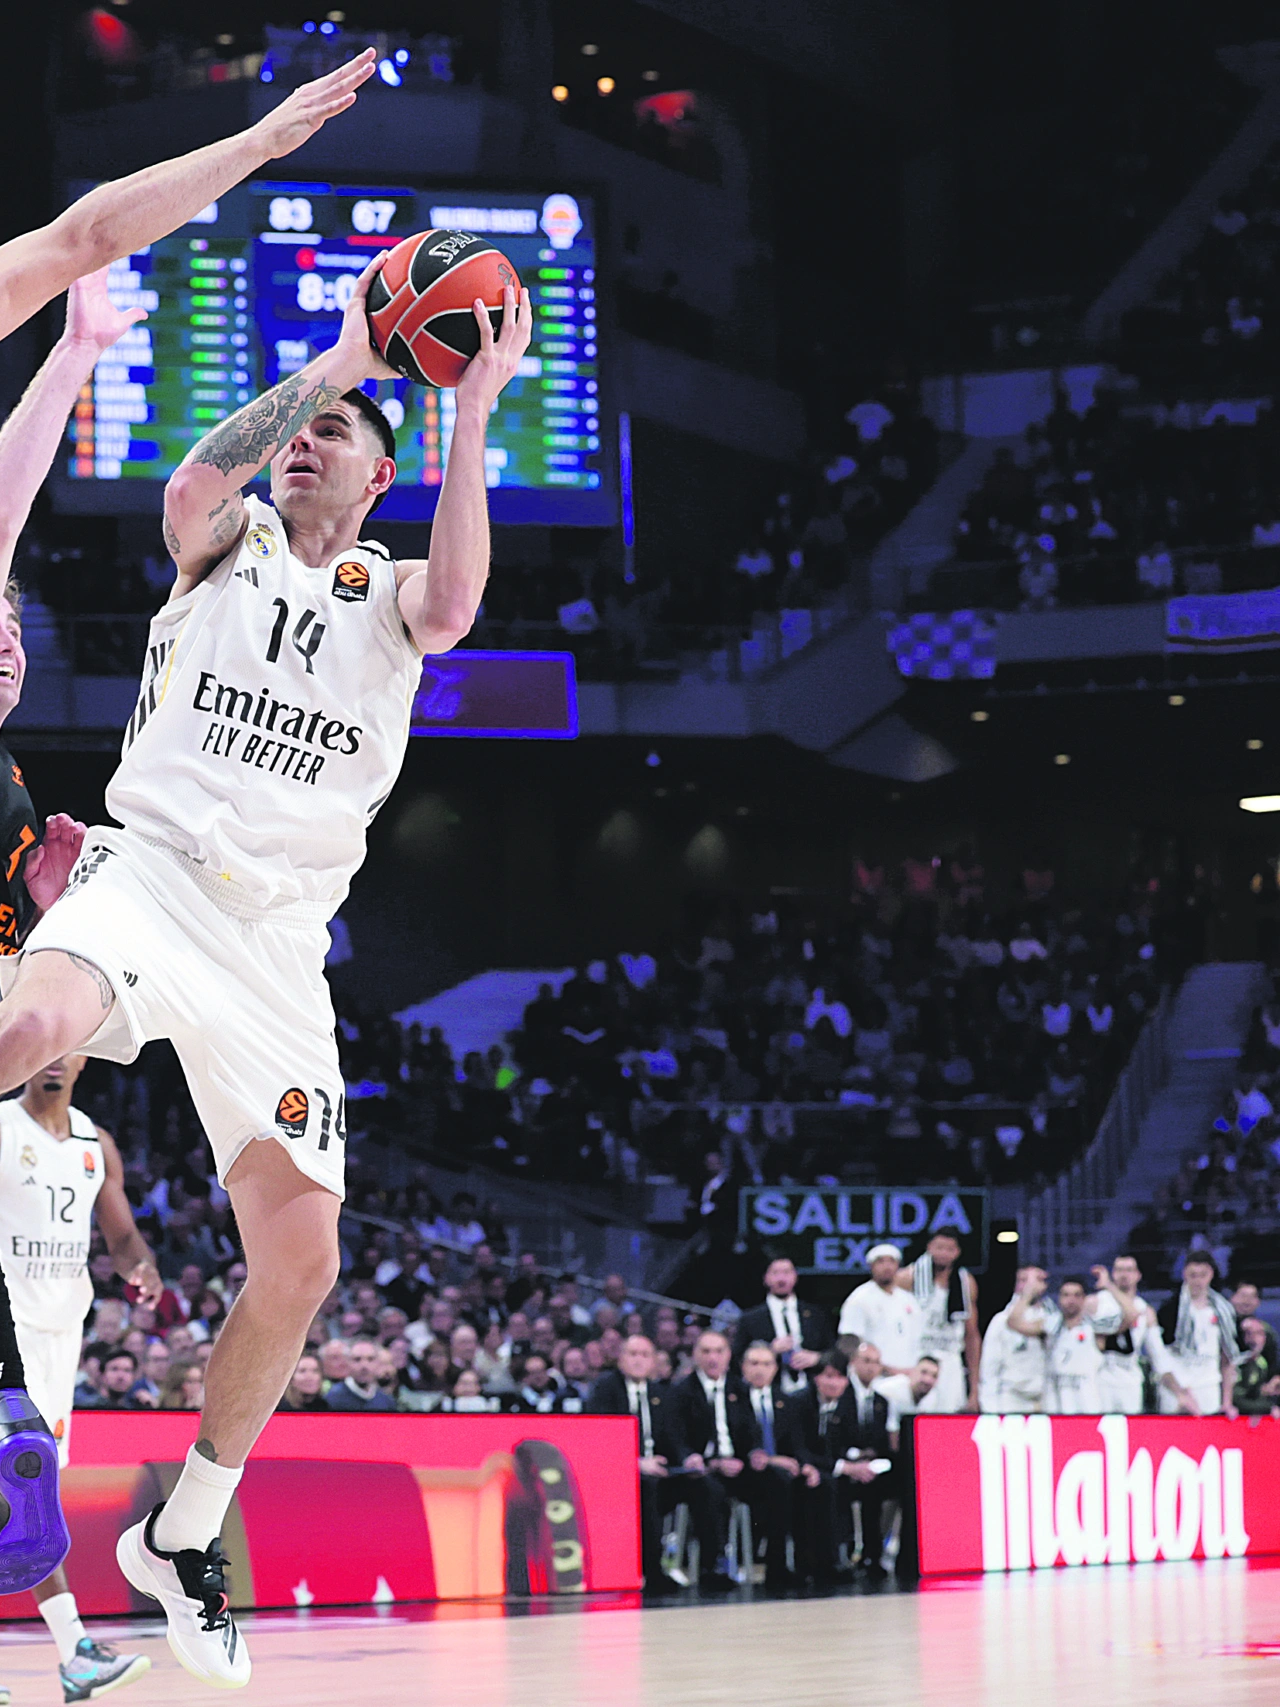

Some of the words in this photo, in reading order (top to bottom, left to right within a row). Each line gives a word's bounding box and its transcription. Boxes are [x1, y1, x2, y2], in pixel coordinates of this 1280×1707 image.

[269, 197, 313, 232] 83
[351, 200, 396, 233] 67
[428, 233, 478, 265] SPAL
[266, 597, 326, 675] 14
[193, 671, 363, 755] Emirates
[202, 722, 241, 757] FLY
[241, 729, 325, 786] BETTER
[46, 1185, 75, 1223] 12
[752, 1192, 972, 1235] SALIDA
[813, 1237, 912, 1271] EX
[970, 1414, 1251, 1572] Mahou
